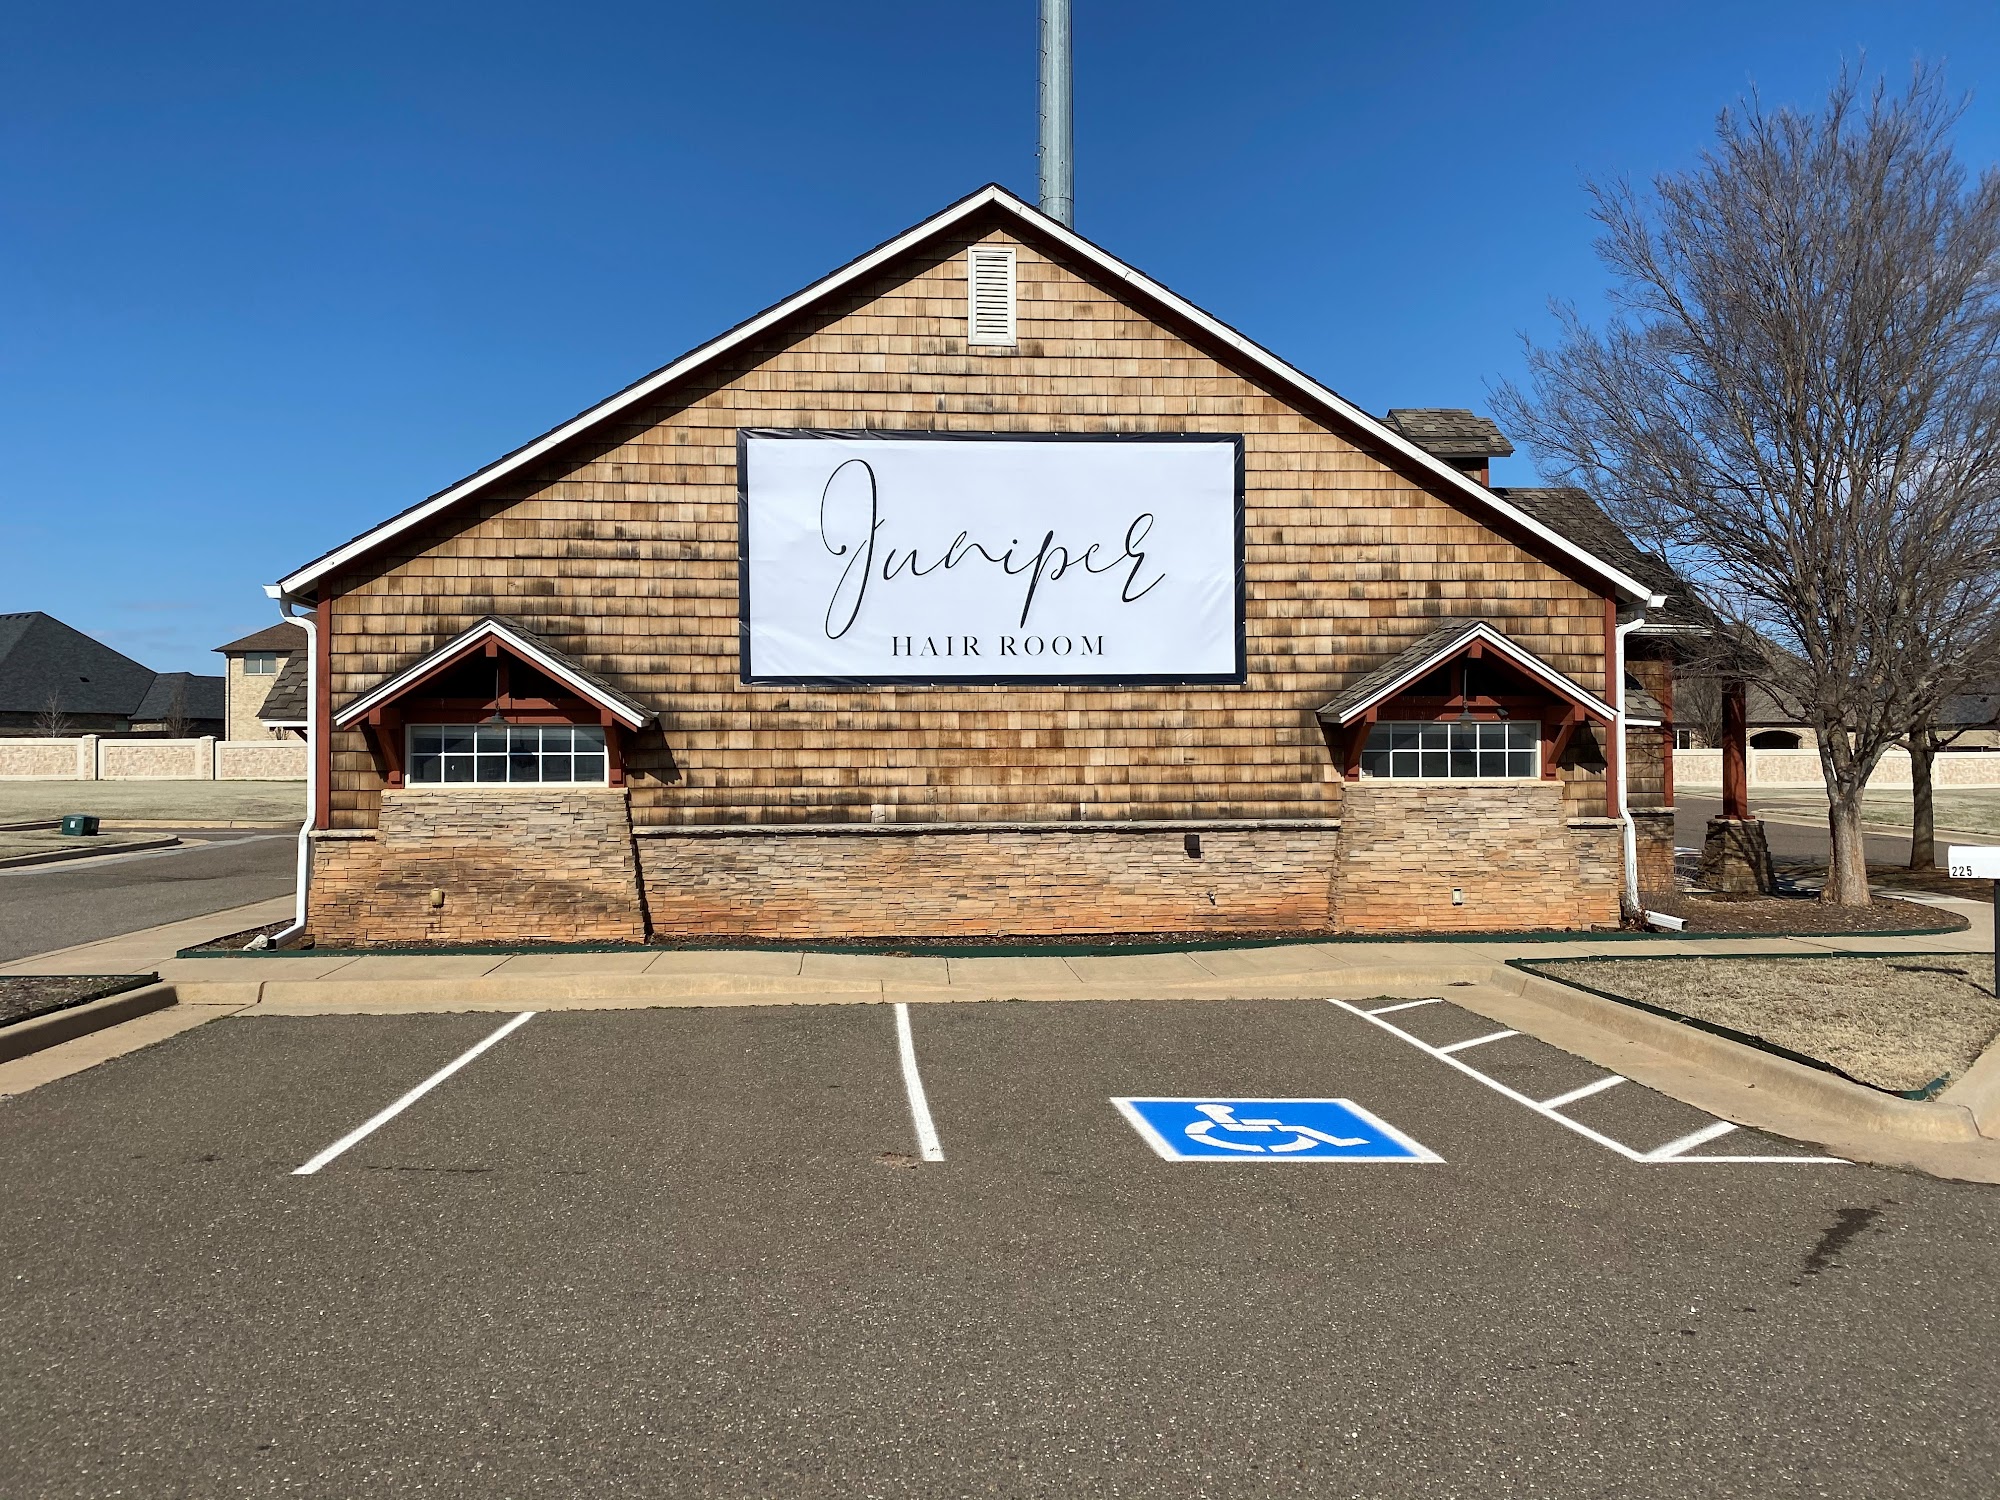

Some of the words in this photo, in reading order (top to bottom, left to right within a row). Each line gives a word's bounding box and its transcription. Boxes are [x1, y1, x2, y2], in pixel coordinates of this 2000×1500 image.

[820, 459, 1166, 640] Juniper
[892, 635, 981, 657] HAIR
[1000, 635, 1105, 657] ROOM
[1951, 865, 1973, 877] 225
